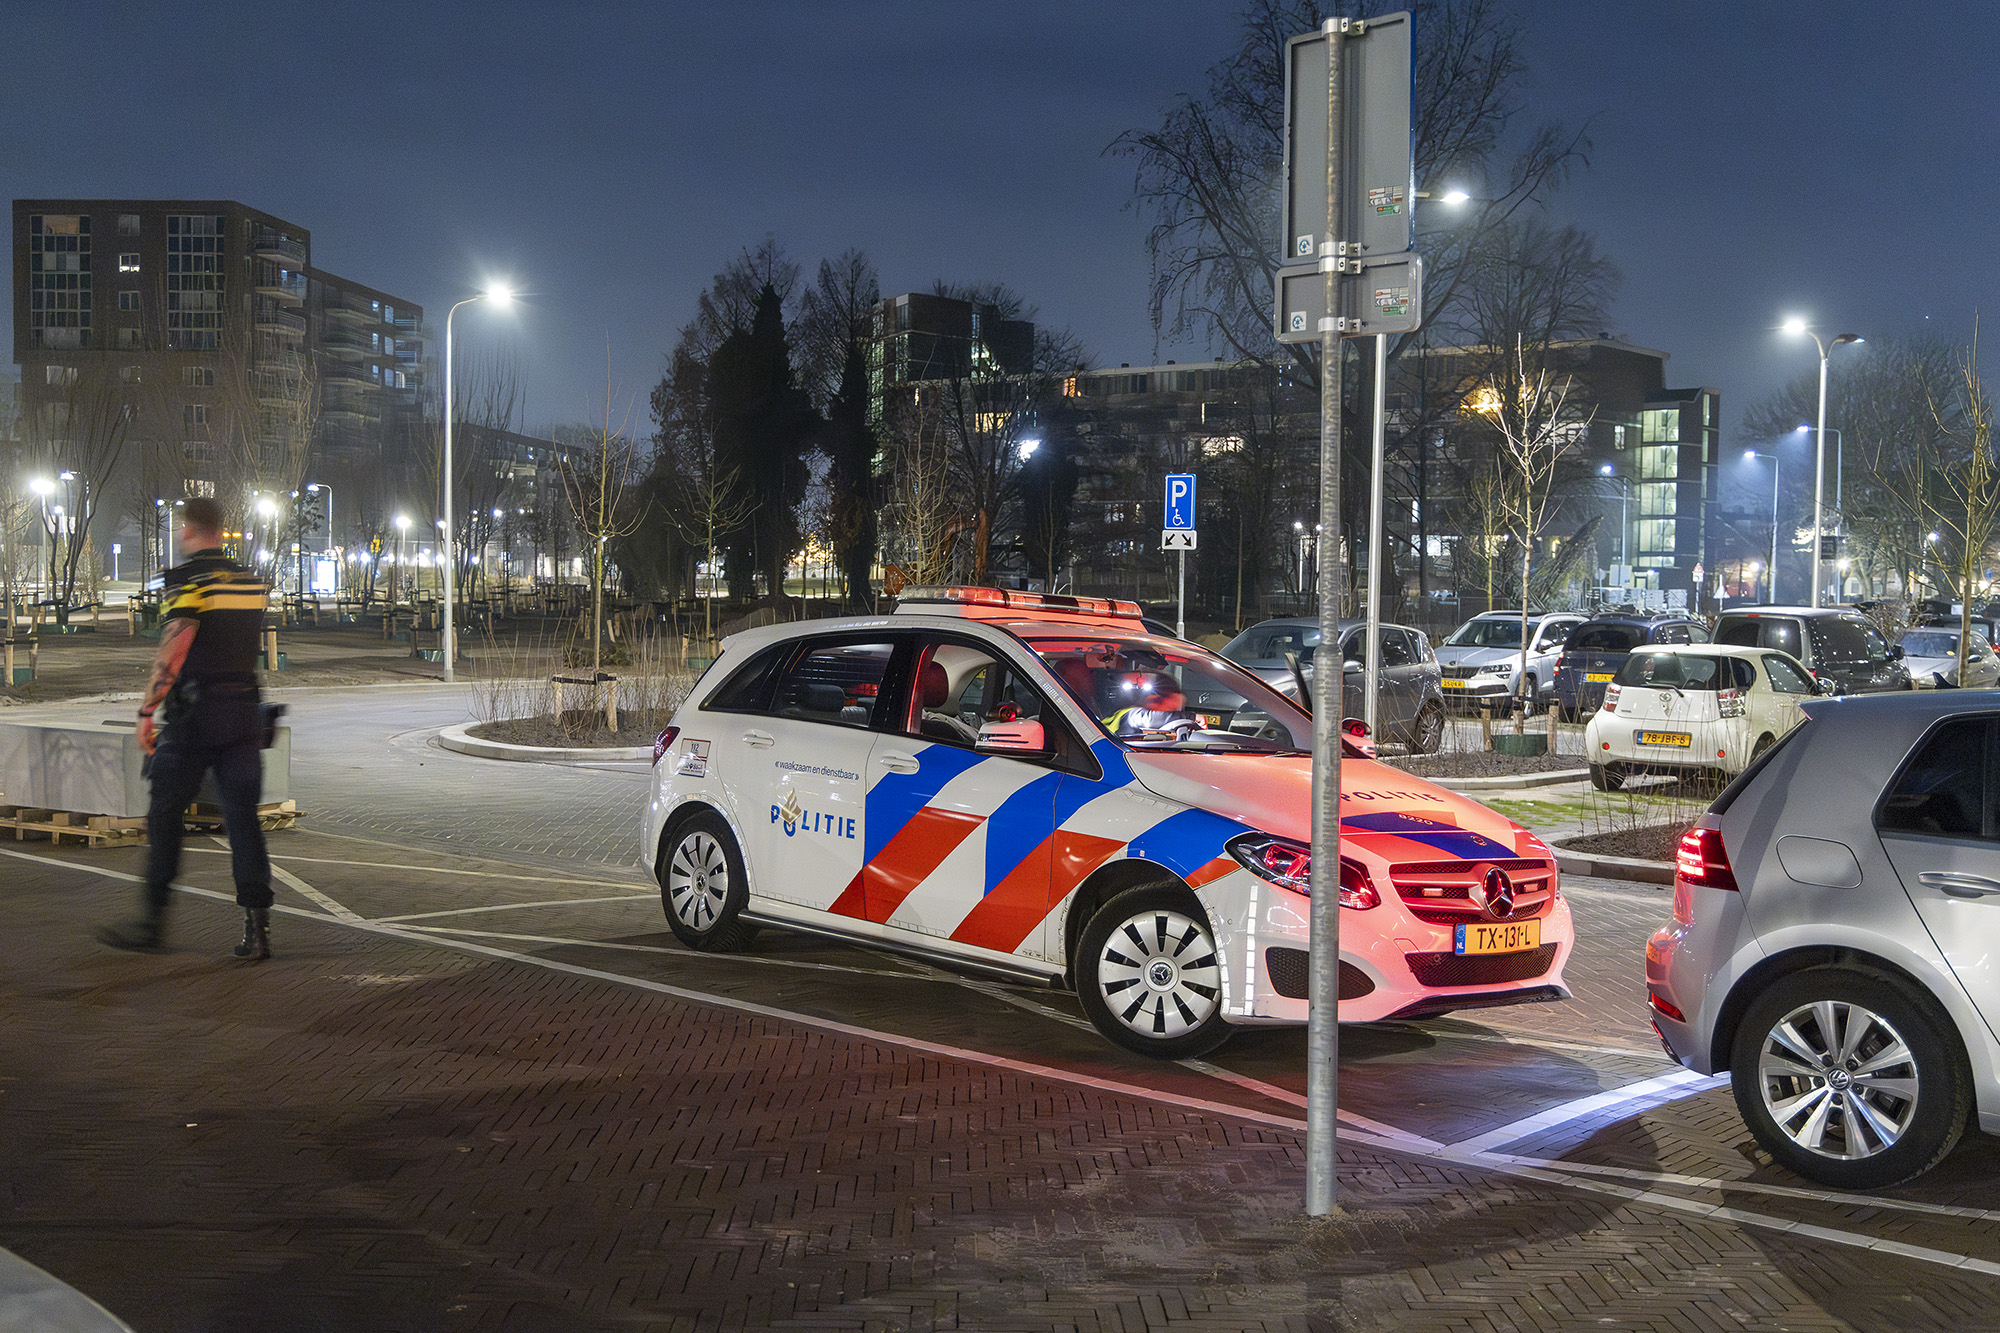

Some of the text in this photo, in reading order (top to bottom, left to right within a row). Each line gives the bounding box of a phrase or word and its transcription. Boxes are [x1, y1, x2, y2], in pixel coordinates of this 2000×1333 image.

[1171, 480, 1188, 508] P
[812, 765, 821, 775] en
[1456, 942, 1465, 950] NL
[1476, 924, 1531, 950] TX-131-L
